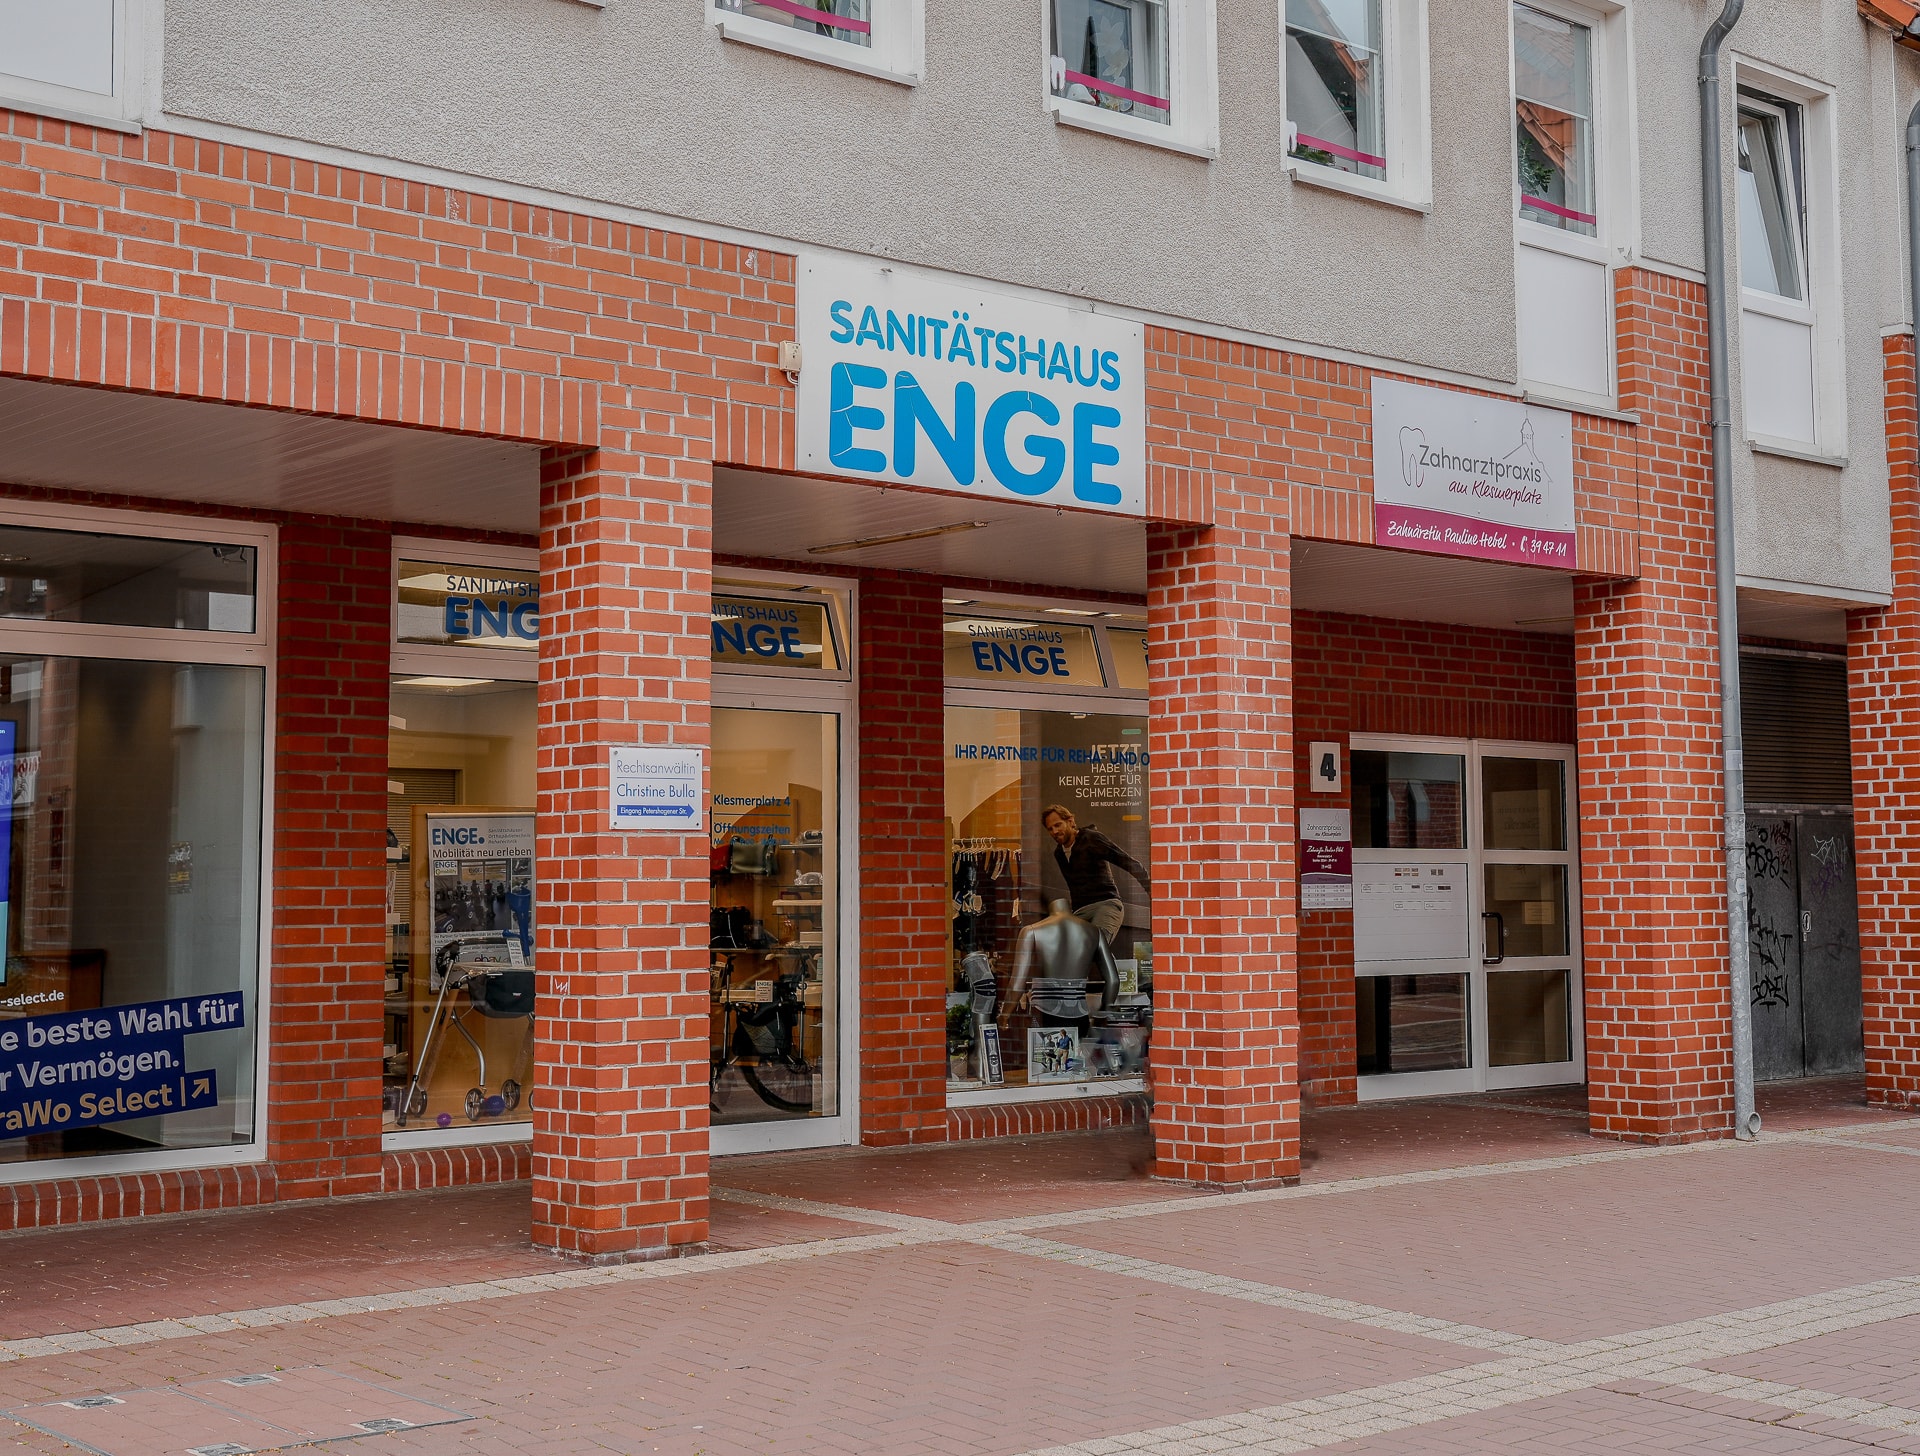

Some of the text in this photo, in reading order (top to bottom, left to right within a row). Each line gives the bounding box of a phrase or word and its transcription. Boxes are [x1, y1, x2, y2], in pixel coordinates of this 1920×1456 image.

[830, 300, 1121, 391] SANITÄTSHAUS
[829, 362, 1122, 506] ENGE
[1419, 444, 1542, 483] Zahnarztpraxis
[1448, 480, 1542, 507] am Klesmerplatz
[1387, 520, 1567, 557] Zahnärztin Pauline Hebel 39 47 11
[711, 621, 804, 658] NGE
[968, 624, 1063, 643] SANITÄTSHAUS
[971, 641, 1070, 677] ENGE
[955, 744, 978, 760] IHR
[981, 745, 1038, 761] PARTNER
[1041, 746, 1065, 763] FÜR
[1110, 751, 1137, 765] UND
[616, 759, 696, 775] Rechtsanwältin
[1091, 762, 1142, 773] HABE ICH
[1320, 753, 1337, 782] 4
[1058, 772, 1142, 786] KEINE ZEIT FÜR
[616, 782, 696, 798] Christine Bulla
[1075, 787, 1142, 798] SCHMERZEN
[713, 793, 791, 808] Klesmerplatz 4
[620, 807, 688, 816] Eingang Petershagener Str.
[432, 827, 485, 846] ENGE.
[713, 822, 791, 836] Öffnungszeiten
[432, 847, 532, 858] Mobilität neu erleben
[0, 990, 65, 1007] -select.de
[27, 1017, 112, 1048] beste
[118, 1002, 193, 1036] Wahl
[197, 999, 239, 1026] für
[17, 1049, 180, 1092] Vermögen.
[79, 1084, 173, 1119] Select
